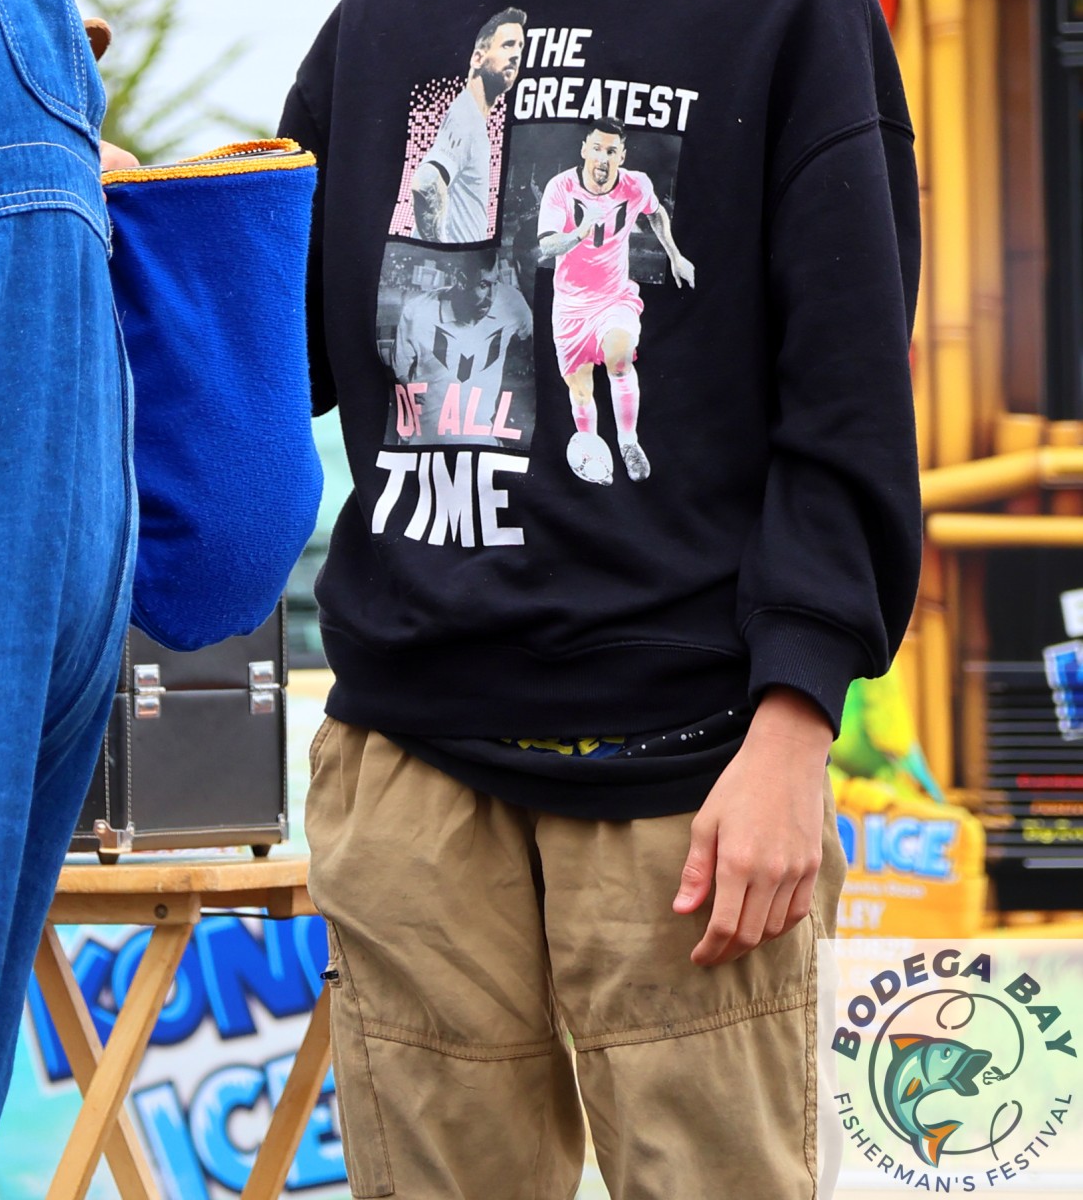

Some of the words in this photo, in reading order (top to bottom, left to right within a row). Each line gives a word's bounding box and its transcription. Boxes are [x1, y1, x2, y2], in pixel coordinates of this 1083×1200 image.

[526, 27, 593, 68] THE
[514, 77, 699, 132] GREATEST
[395, 382, 428, 437] OF
[437, 383, 522, 440] ALL
[371, 450, 530, 548] TIME
[863, 813, 957, 880] ICE
